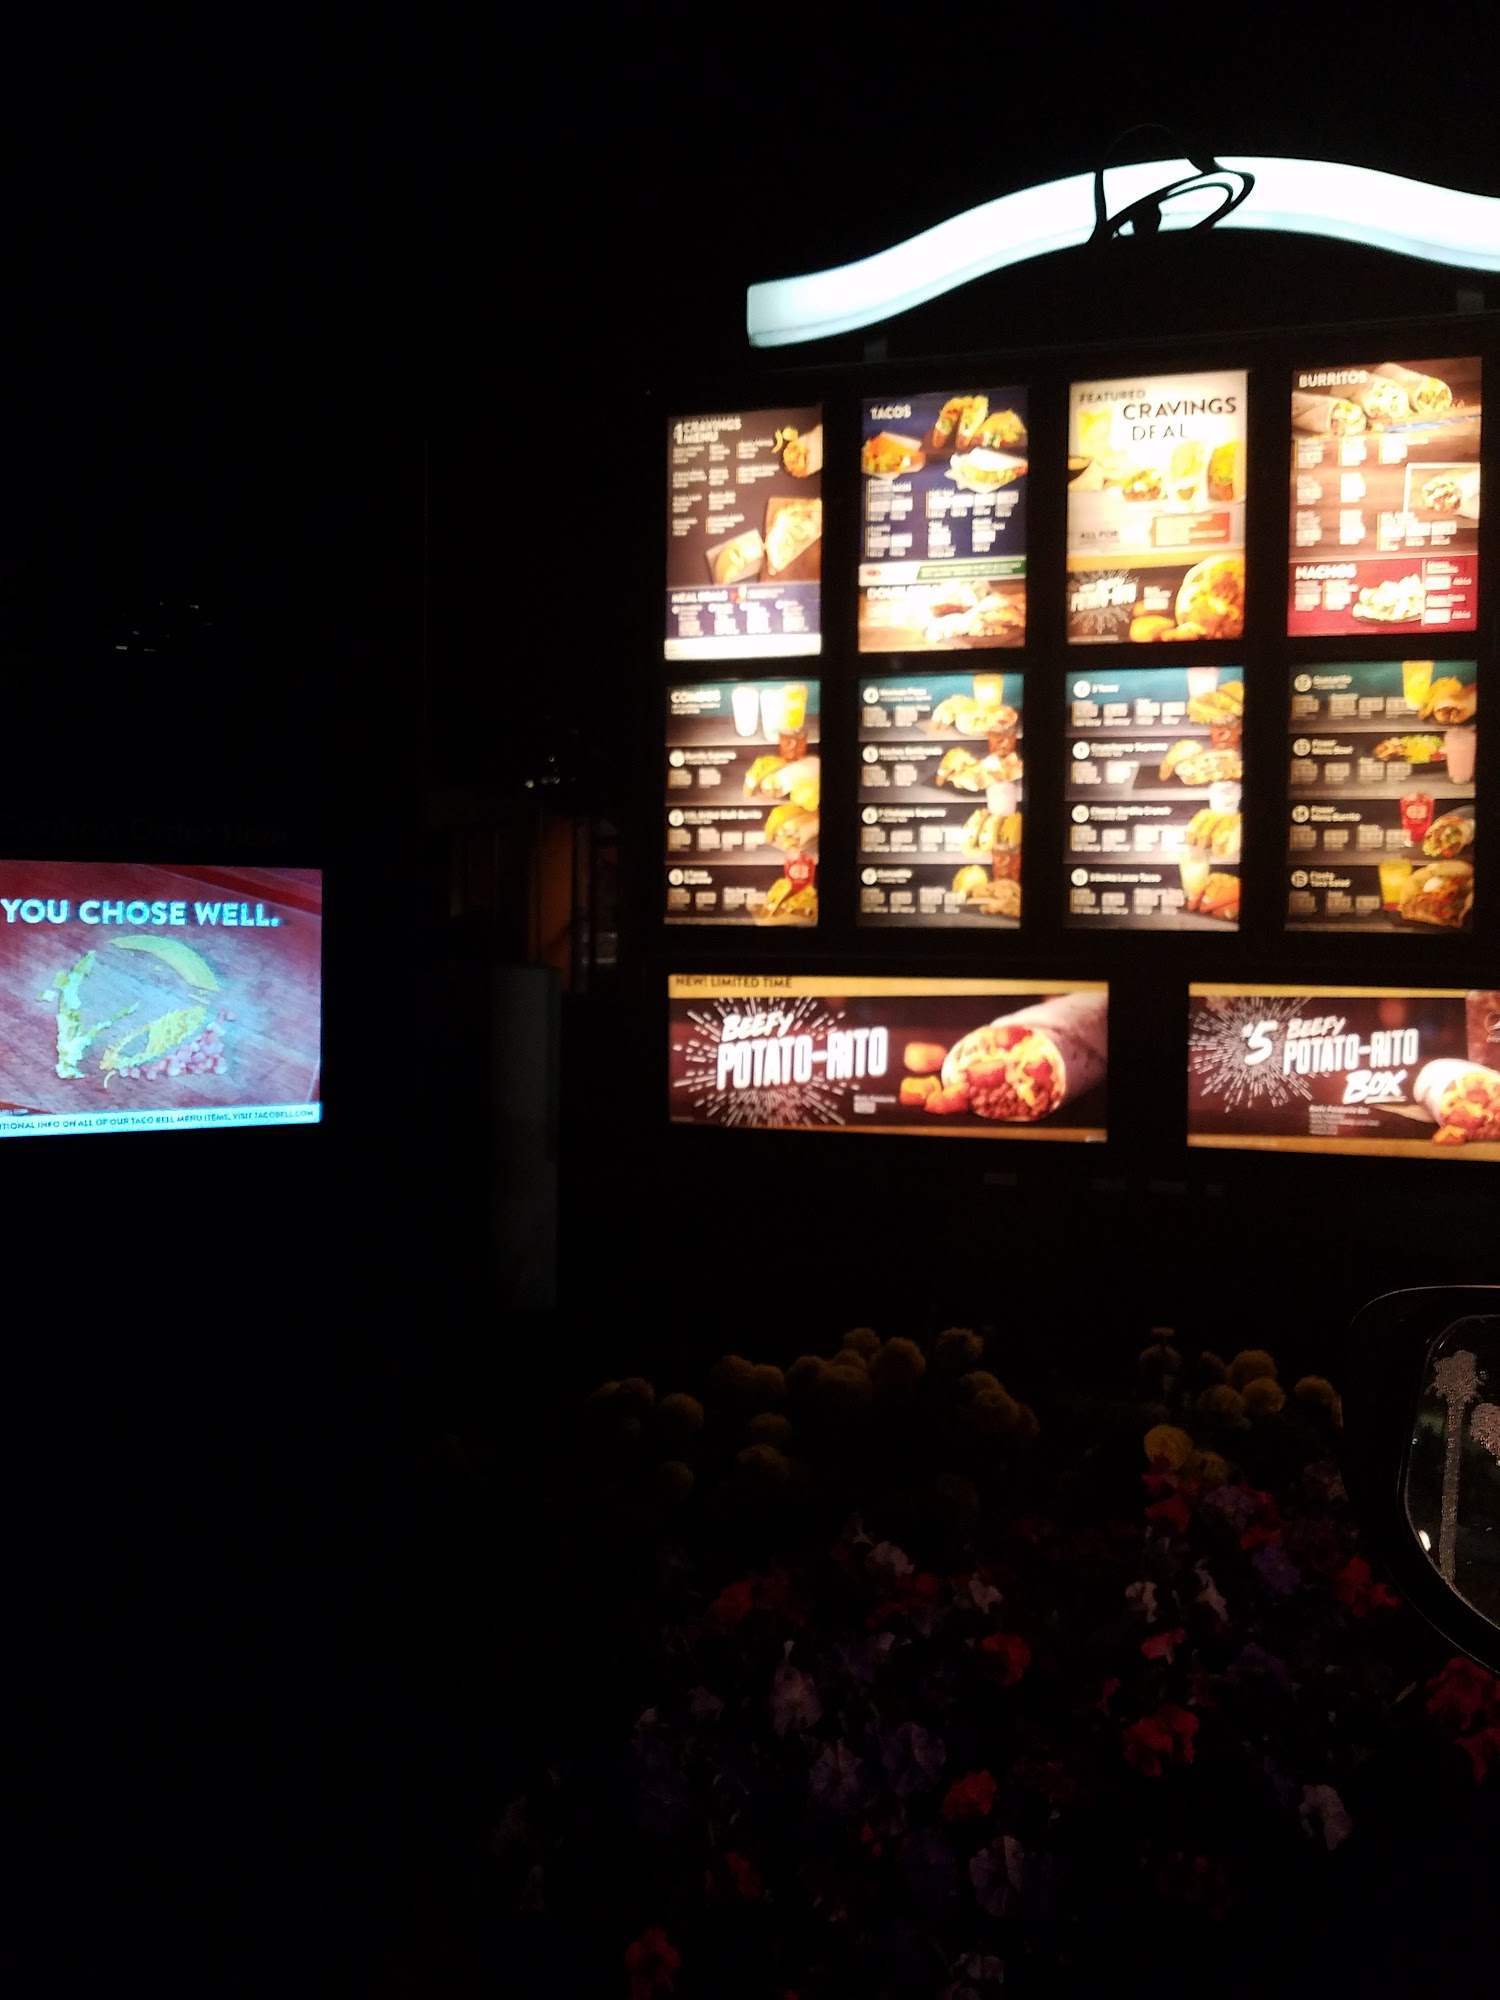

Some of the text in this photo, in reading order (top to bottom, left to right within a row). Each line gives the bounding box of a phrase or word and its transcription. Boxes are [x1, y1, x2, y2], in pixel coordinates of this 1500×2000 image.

[1299, 370, 1367, 388] BURRITOS
[1079, 390, 1146, 404] FEATURED
[1123, 397, 1237, 420] CRAVINGS
[870, 404, 911, 420] TACOS
[0, 898, 280, 927] YOU CHOSE WELL.
[711, 977, 760, 988] LIMITED
[763, 978, 792, 988] TIME
[716, 1027, 889, 1091] POTATO-RITO
[1283, 1028, 1419, 1076] POTATO-RITO
[1342, 1069, 1408, 1105] BOX
